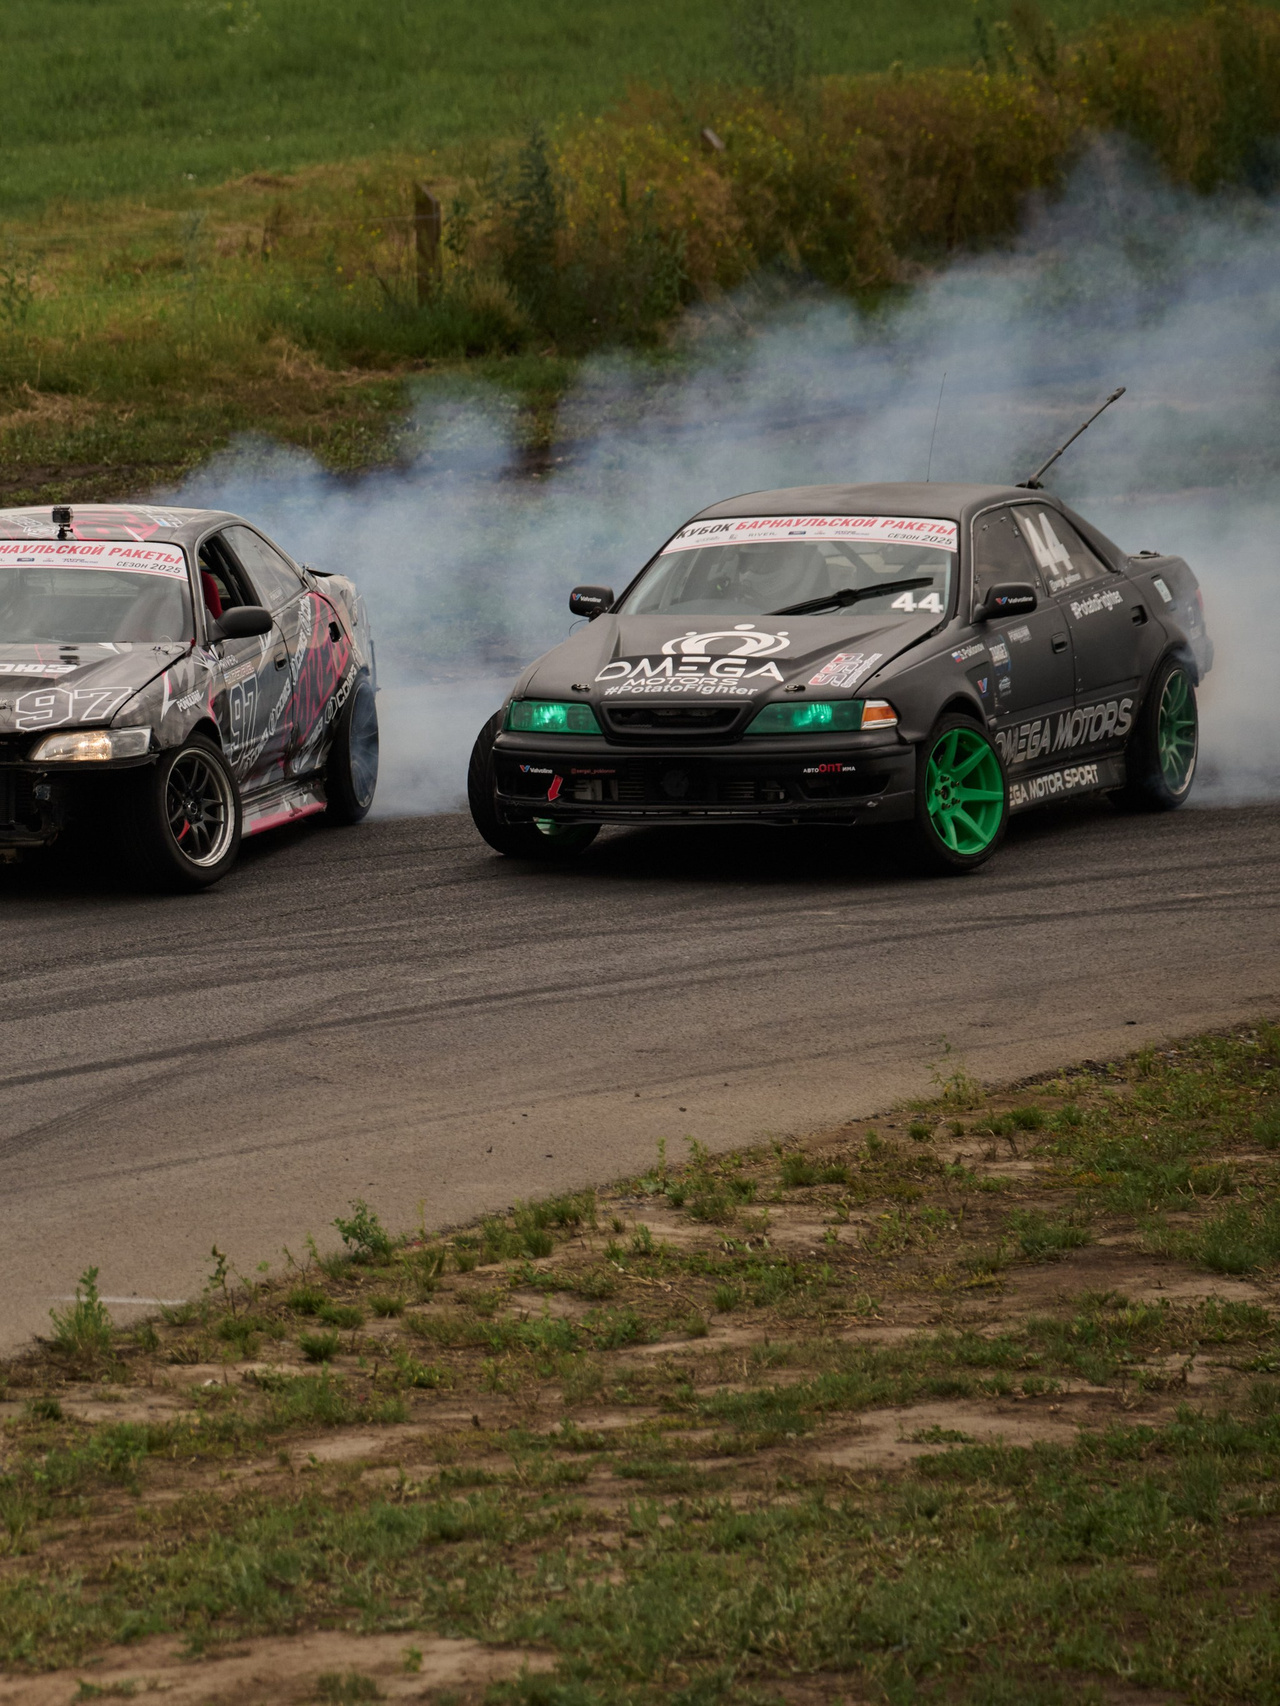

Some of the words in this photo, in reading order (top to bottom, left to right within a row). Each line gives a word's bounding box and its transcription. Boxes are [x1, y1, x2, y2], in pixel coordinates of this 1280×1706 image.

[677, 523, 734, 539] КУБОК
[735, 517, 878, 531] БАРНАУЛЬСКОЙ
[880, 519, 957, 536] РАКЕТЫ
[887, 533, 920, 541] СЕЗОН
[921, 535, 955, 546] 2025
[1025, 512, 1074, 575] 44
[108, 547, 184, 565] РАКЕТЫ
[116, 561, 149, 569] СЕЗОН
[150, 563, 183, 574] 2025
[891, 592, 944, 614] 44
[595, 656, 785, 682] OMEGA
[604, 683, 758, 696] #PotatoFighter
[622, 677, 739, 687] MOTORS
[15, 686, 133, 731] 97
[230, 673, 258, 767] 97
[1052, 698, 1133, 752] MOTORS
[530, 767, 554, 775] Valvoline
[1028, 771, 1065, 800] MOTOR
[1064, 763, 1099, 789] SPORT
